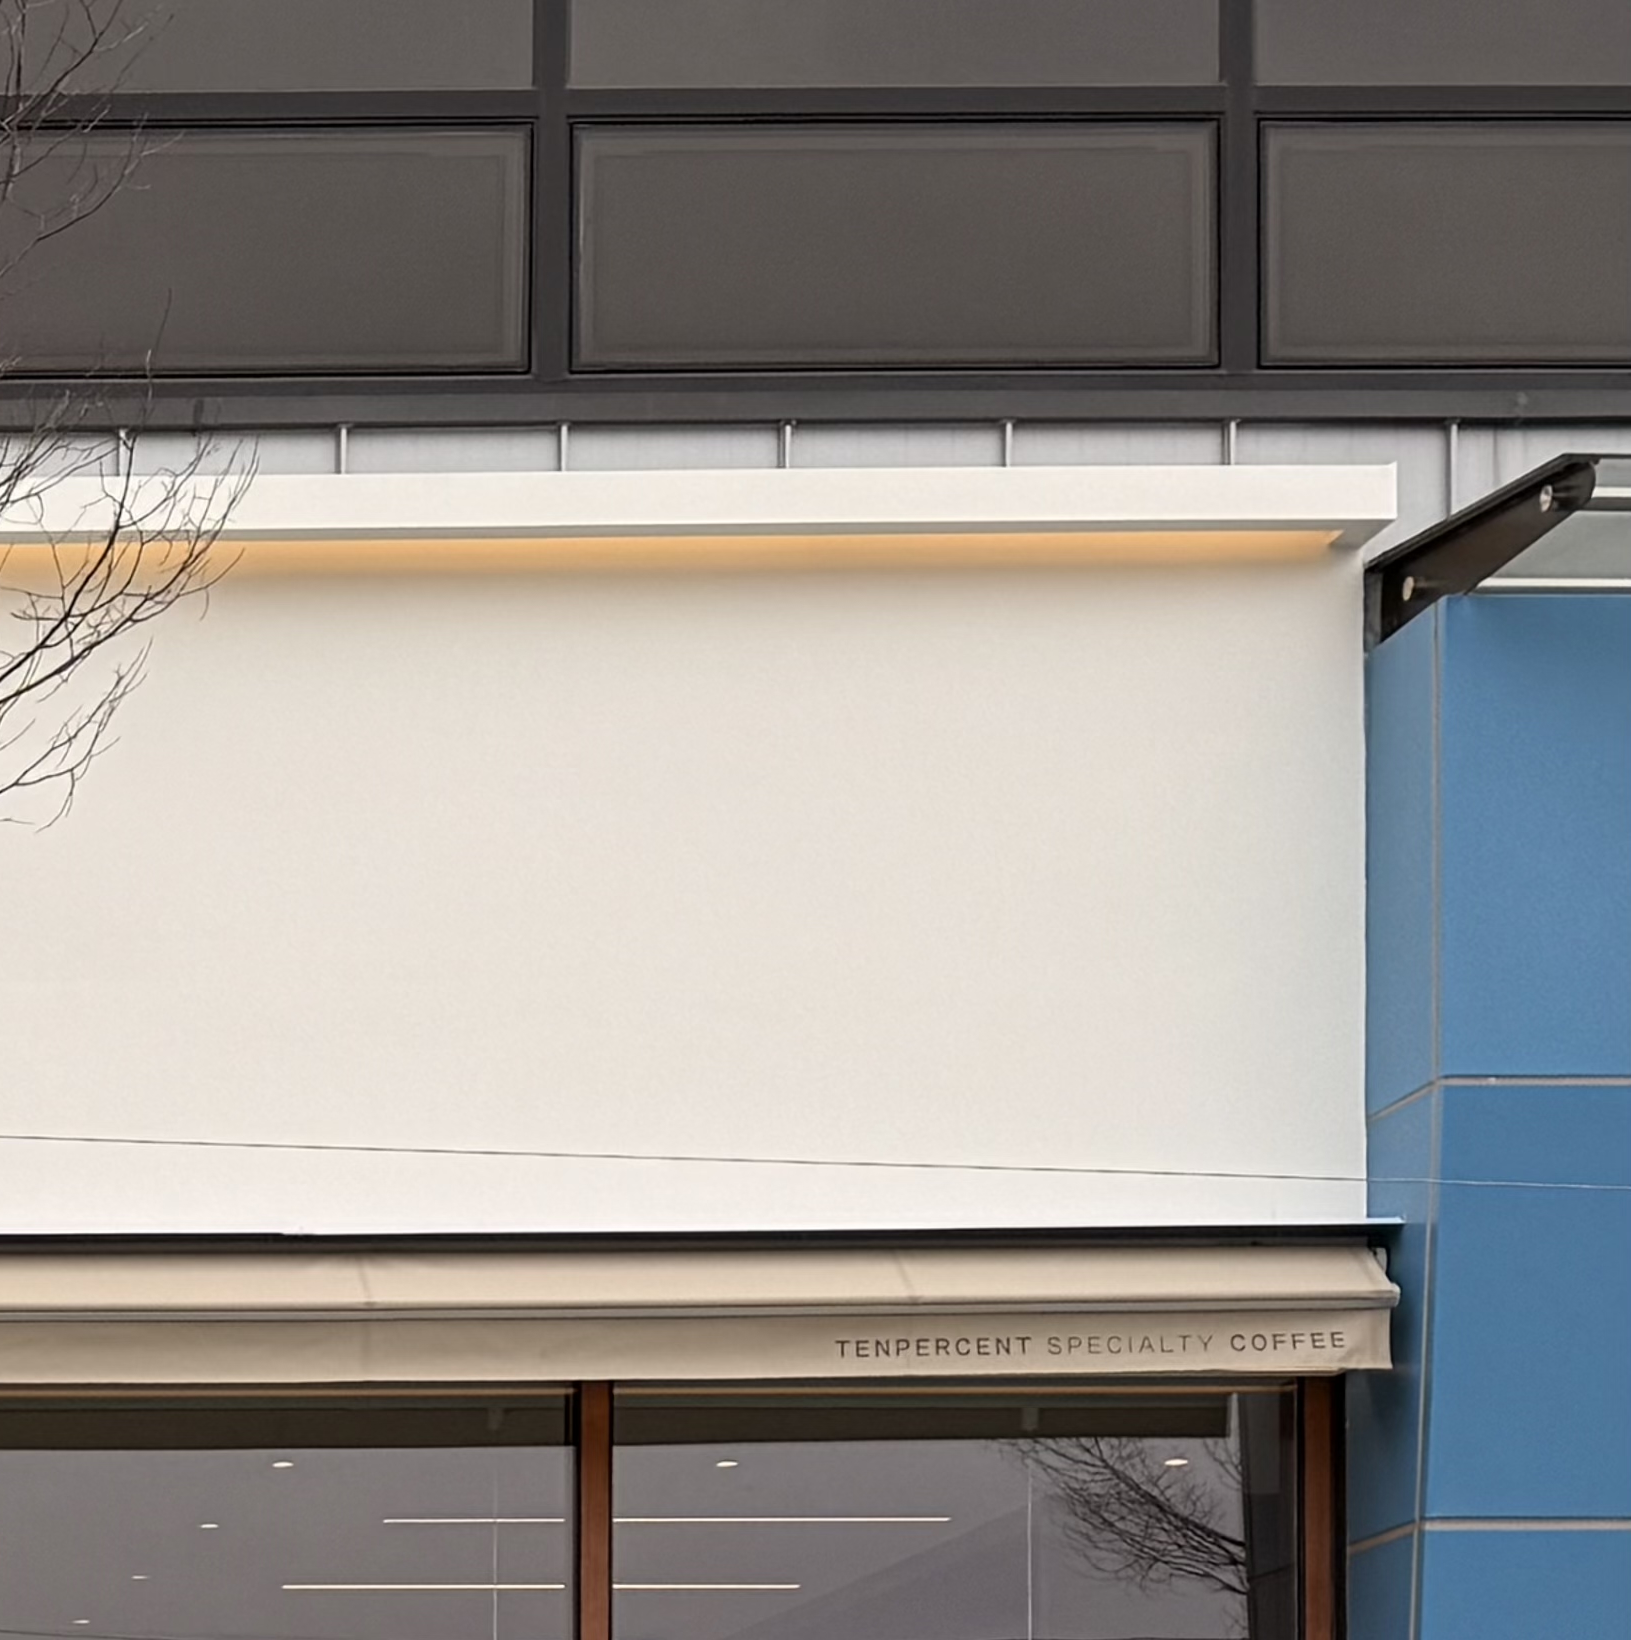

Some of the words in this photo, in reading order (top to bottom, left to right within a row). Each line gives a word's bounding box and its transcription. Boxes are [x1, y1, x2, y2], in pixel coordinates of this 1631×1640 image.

[835, 1337, 1033, 1359] TENPERCENT
[1046, 1334, 1215, 1356] SPECIALTY
[1229, 1331, 1346, 1353] COFFEE
